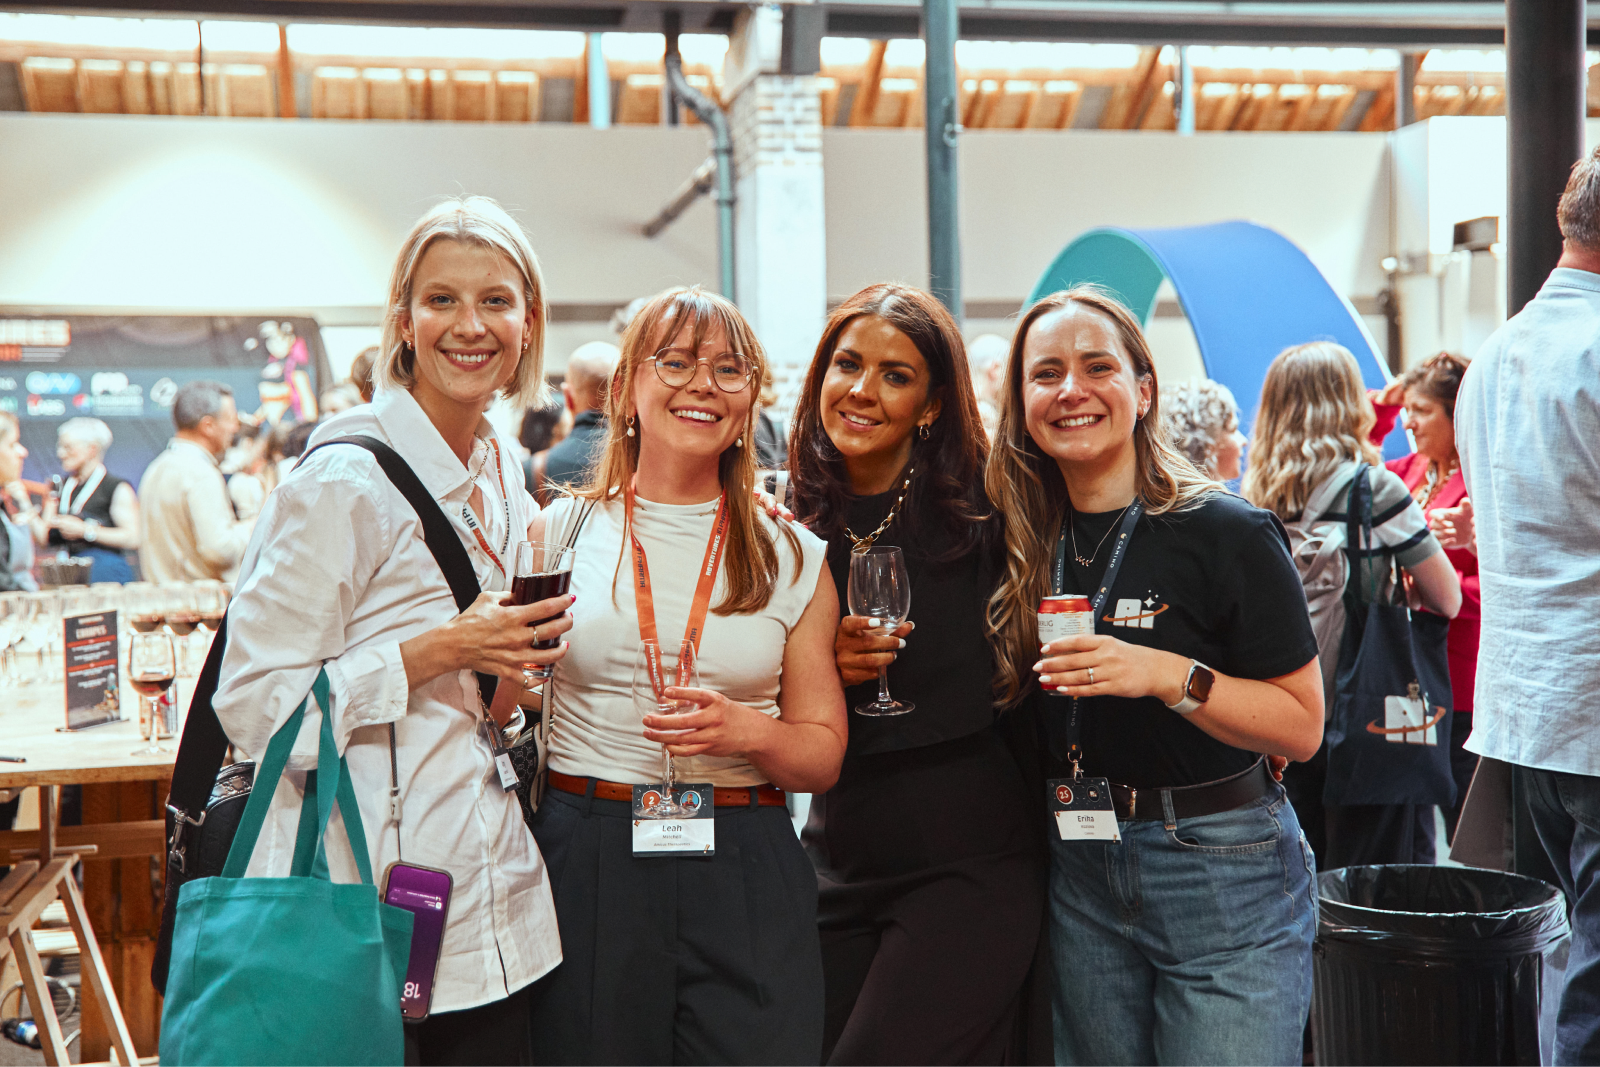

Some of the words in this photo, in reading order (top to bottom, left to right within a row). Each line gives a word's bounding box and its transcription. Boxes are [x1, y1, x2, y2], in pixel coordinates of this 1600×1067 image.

[466, 516, 477, 529] IN
[706, 534, 721, 576] ADVENTURES
[716, 526, 724, 535] IN
[1110, 540, 1124, 569] CAMINO
[637, 556, 646, 588] PHARMA
[1070, 702, 1079, 727] CAMINO
[1060, 790, 1069, 799] 25
[403, 981, 420, 999] 18
